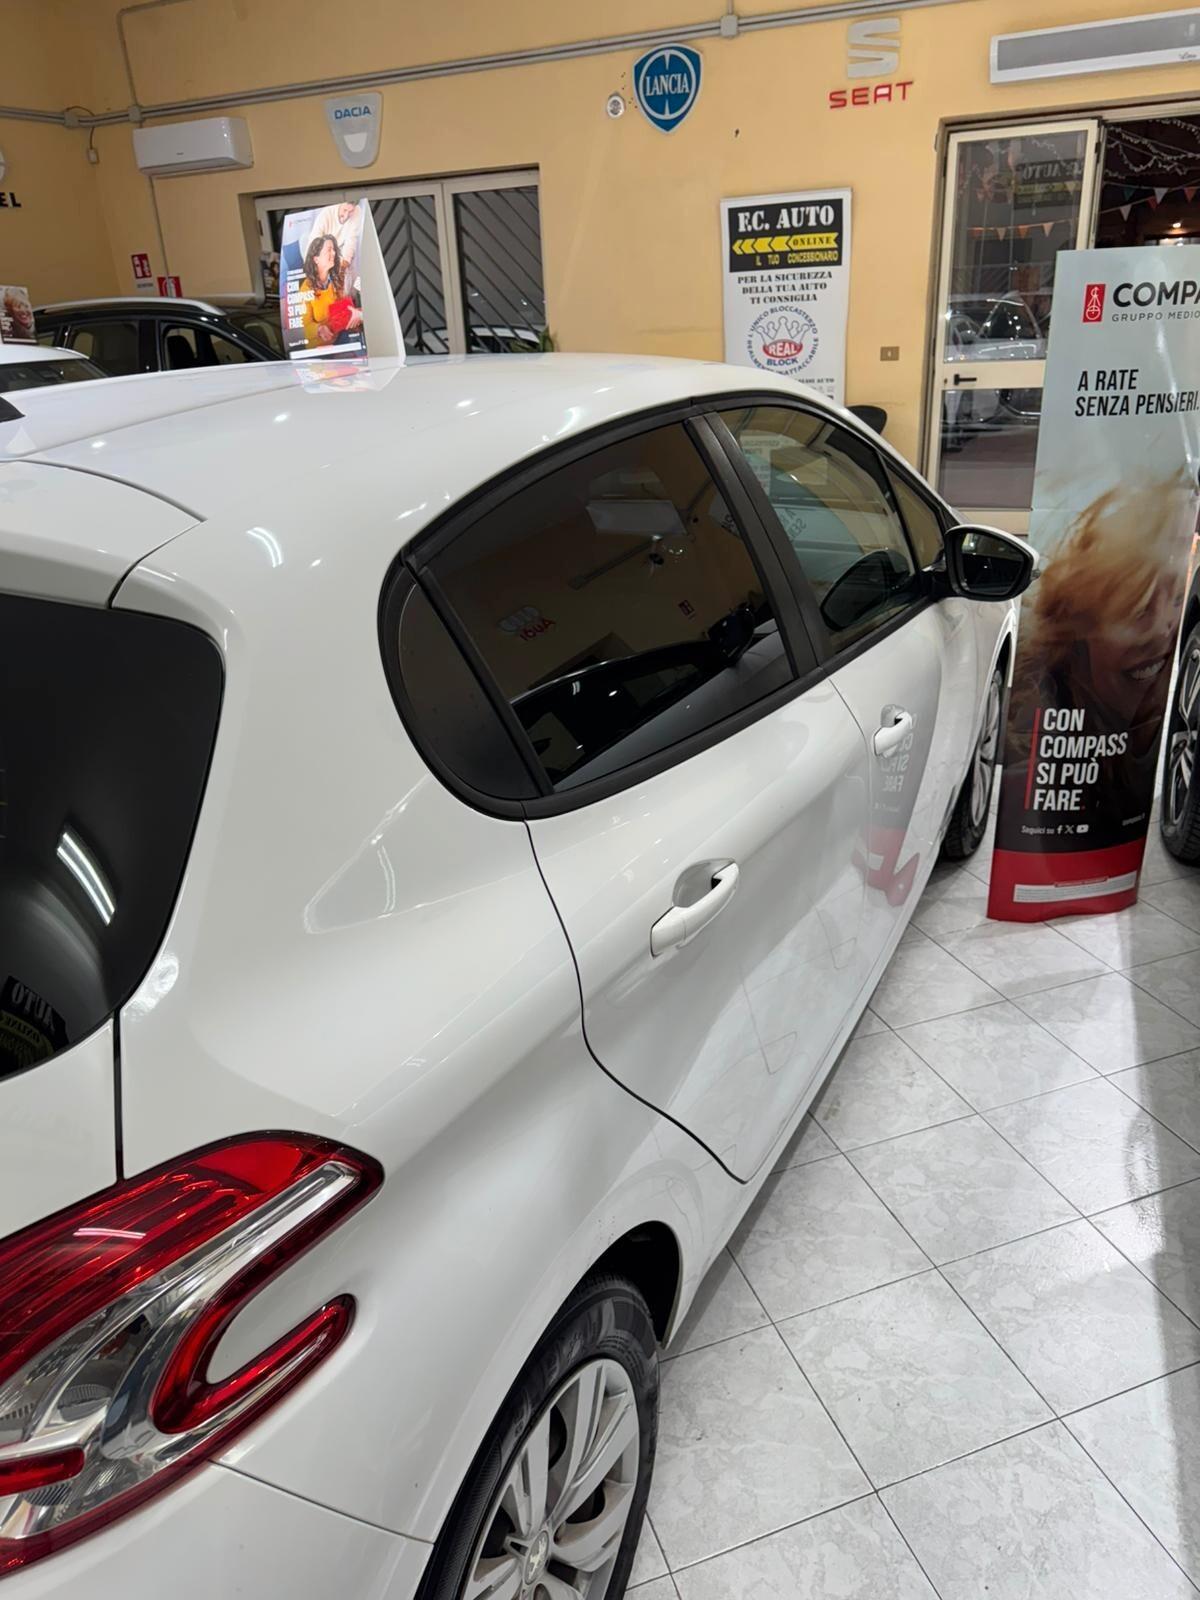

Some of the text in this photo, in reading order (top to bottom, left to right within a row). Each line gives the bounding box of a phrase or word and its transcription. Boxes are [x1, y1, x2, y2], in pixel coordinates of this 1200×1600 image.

[645, 72, 690, 97] LANCIA
[829, 81, 914, 109] SEAT
[334, 105, 372, 120] DACIA
[738, 205, 835, 232] F.C. AUTO
[792, 235, 833, 246] ONLINE
[787, 250, 839, 264] CONCESSIONARIO
[737, 271, 833, 284] PER LA SICUREZZA
[742, 282, 827, 295] DELLA TUA AUTO
[1112, 280, 1200, 308] COMP
[750, 293, 818, 305] TI CONSIGLIA
[1112, 311, 1163, 322] GRUPPO
[768, 342, 798, 357] REAL
[766, 358, 799, 367] BLOCK
[1077, 368, 1139, 391] A RATE
[1074, 394, 1130, 417] SENZA
[1042, 708, 1086, 732] CON
[1039, 732, 1129, 759] COMPASS
[1036, 757, 1100, 785] SI PUÒ
